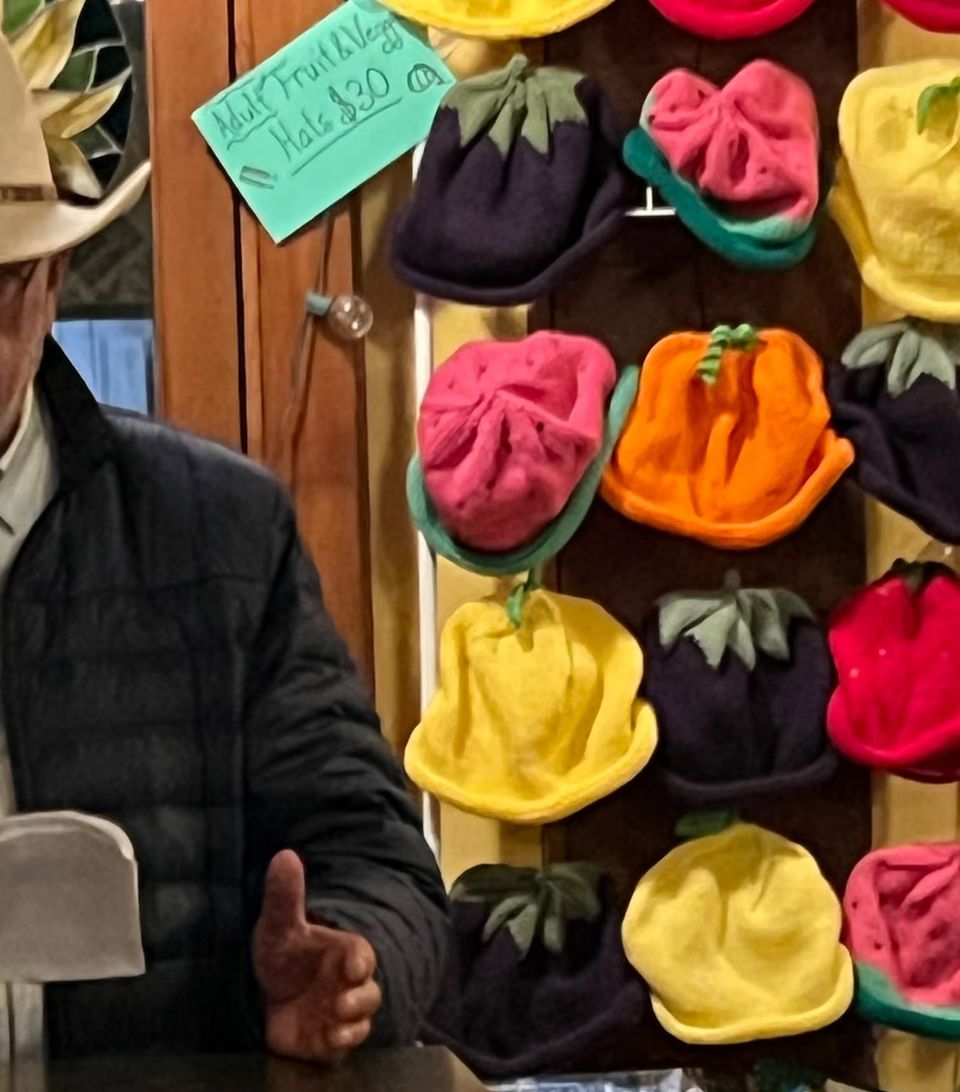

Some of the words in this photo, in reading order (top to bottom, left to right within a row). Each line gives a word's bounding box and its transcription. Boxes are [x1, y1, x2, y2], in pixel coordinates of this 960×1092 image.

[211, 85, 273, 139] Adult
[257, 43, 337, 99] Fruit
[331, 31, 354, 61] &
[267, 109, 334, 162] Hats
[328, 67, 390, 126] $30
